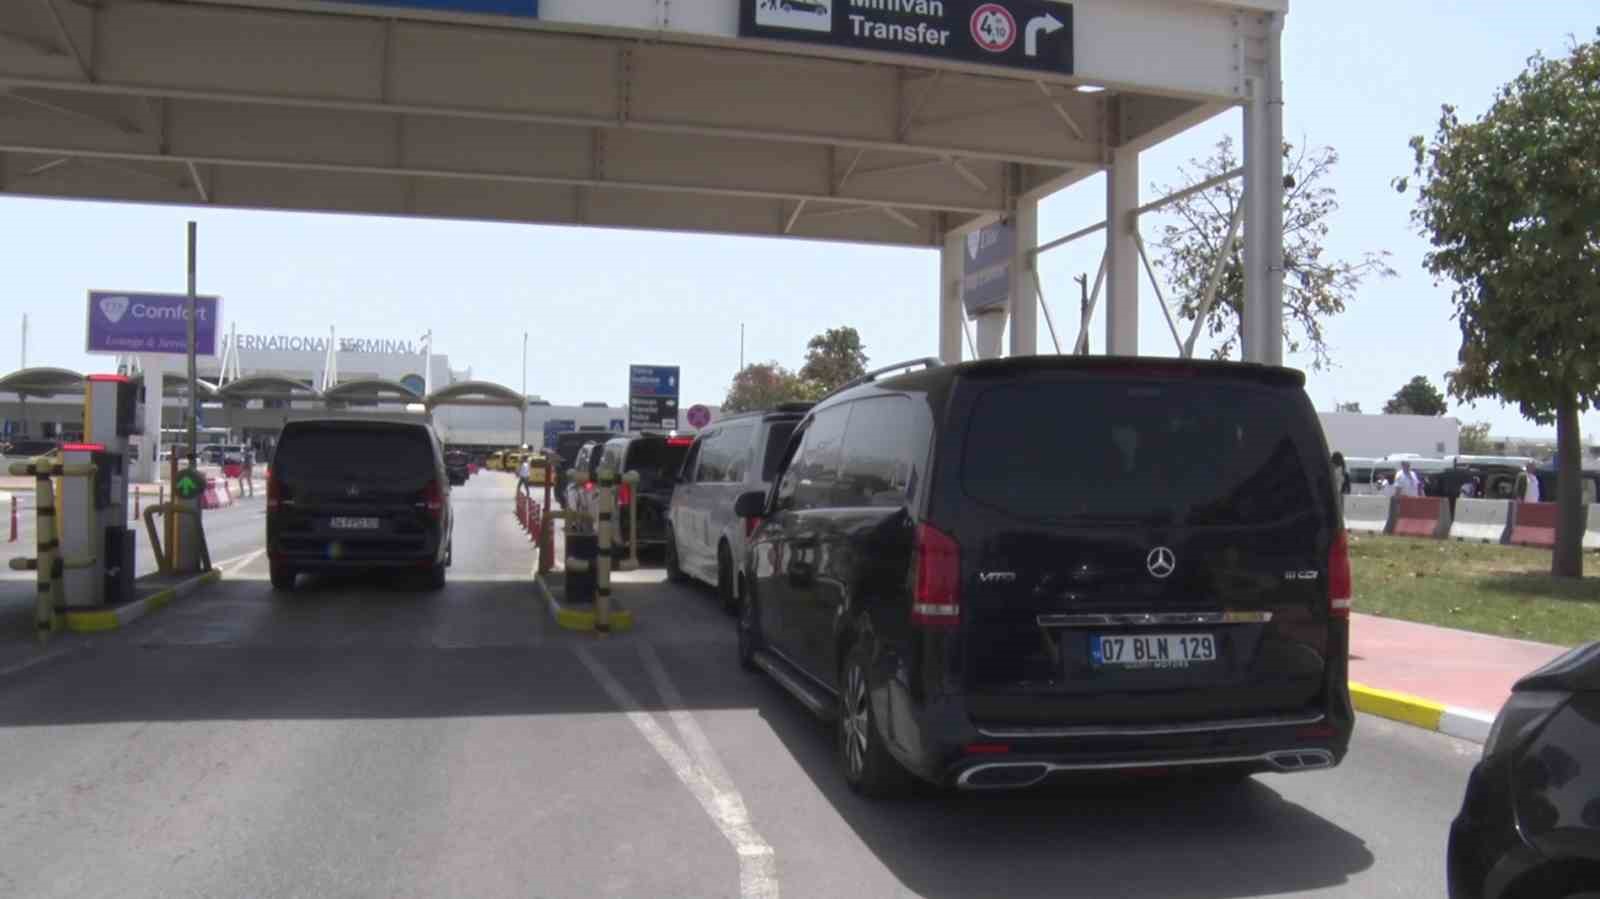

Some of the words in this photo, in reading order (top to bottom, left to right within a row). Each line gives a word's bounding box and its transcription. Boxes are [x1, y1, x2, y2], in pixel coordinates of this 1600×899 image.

[848, 14, 950, 46] Transfer
[1103, 638, 1125, 661] 07
[1134, 637, 1169, 661] BLN
[1180, 636, 1214, 659] 129
